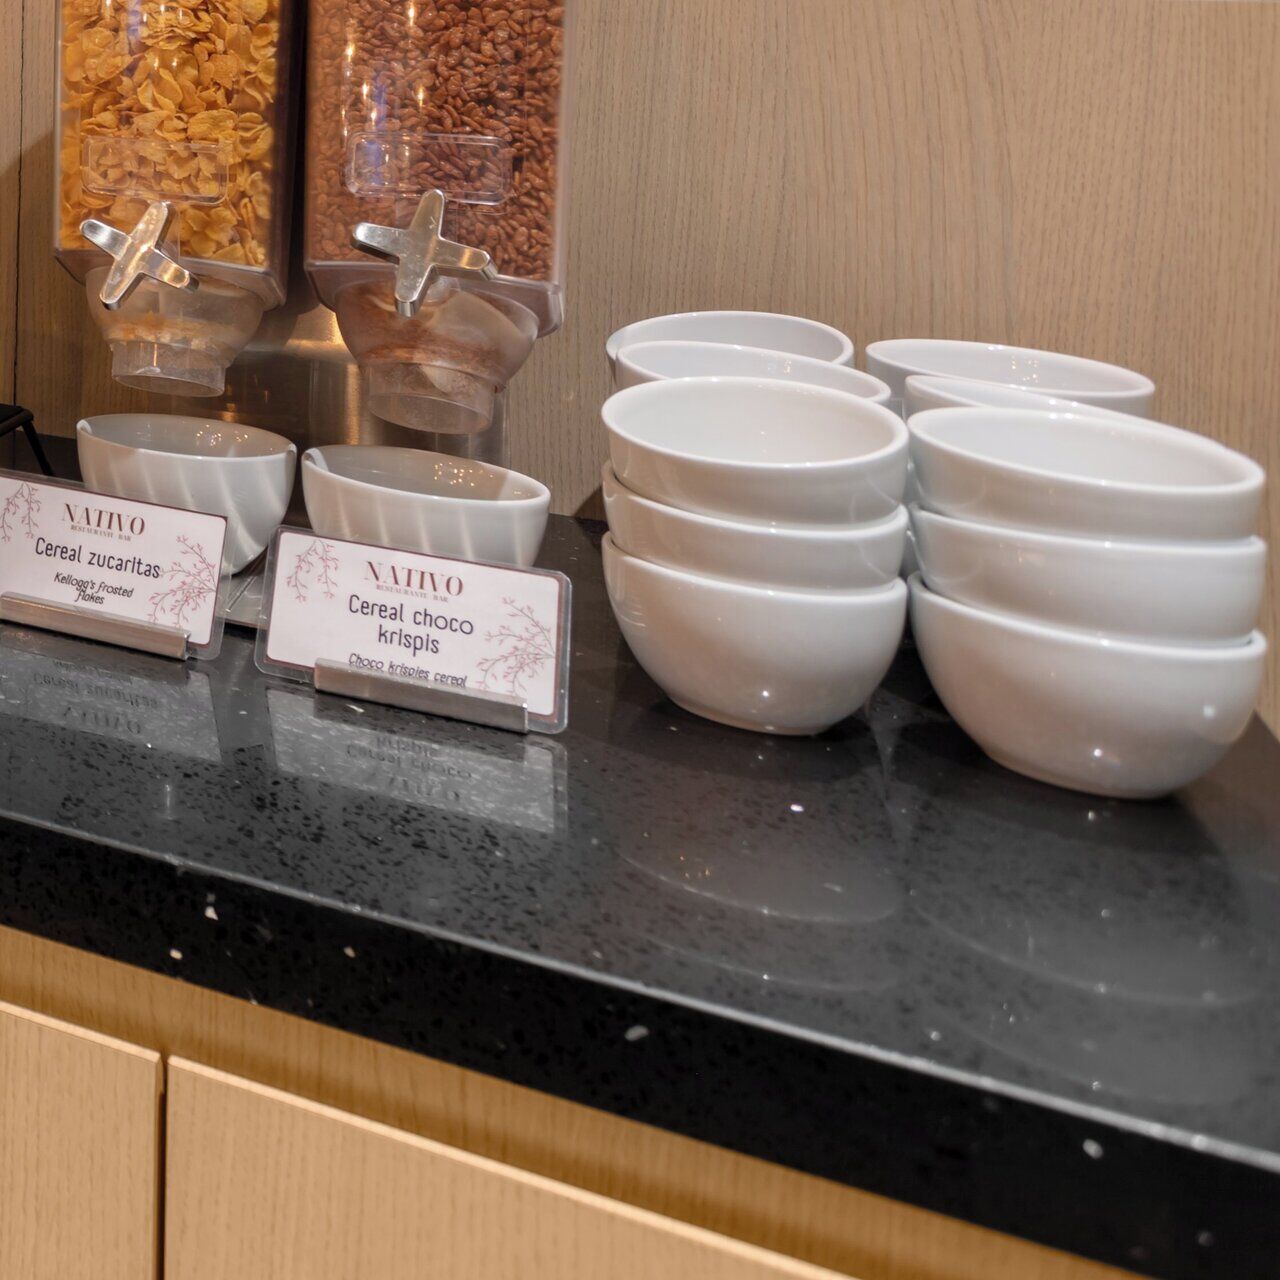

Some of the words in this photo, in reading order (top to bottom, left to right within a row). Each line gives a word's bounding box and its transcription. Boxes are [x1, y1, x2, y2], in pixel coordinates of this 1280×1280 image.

[62, 502, 146, 537] NATIVO
[35, 537, 82, 564] Cereal
[87, 551, 161, 579] zucaritas
[53, 571, 96, 594] Kellogg's
[94, 580, 135, 599] frosted
[363, 560, 465, 598] NATIVO
[74, 588, 106, 606] flakes
[432, 594, 449, 604] BAR
[348, 594, 405, 623] Cereal
[412, 607, 474, 636] choco
[377, 624, 441, 657] krispis
[348, 653, 385, 670] Choco
[387, 661, 430, 680] krispies
[433, 671, 468, 688] cereal
